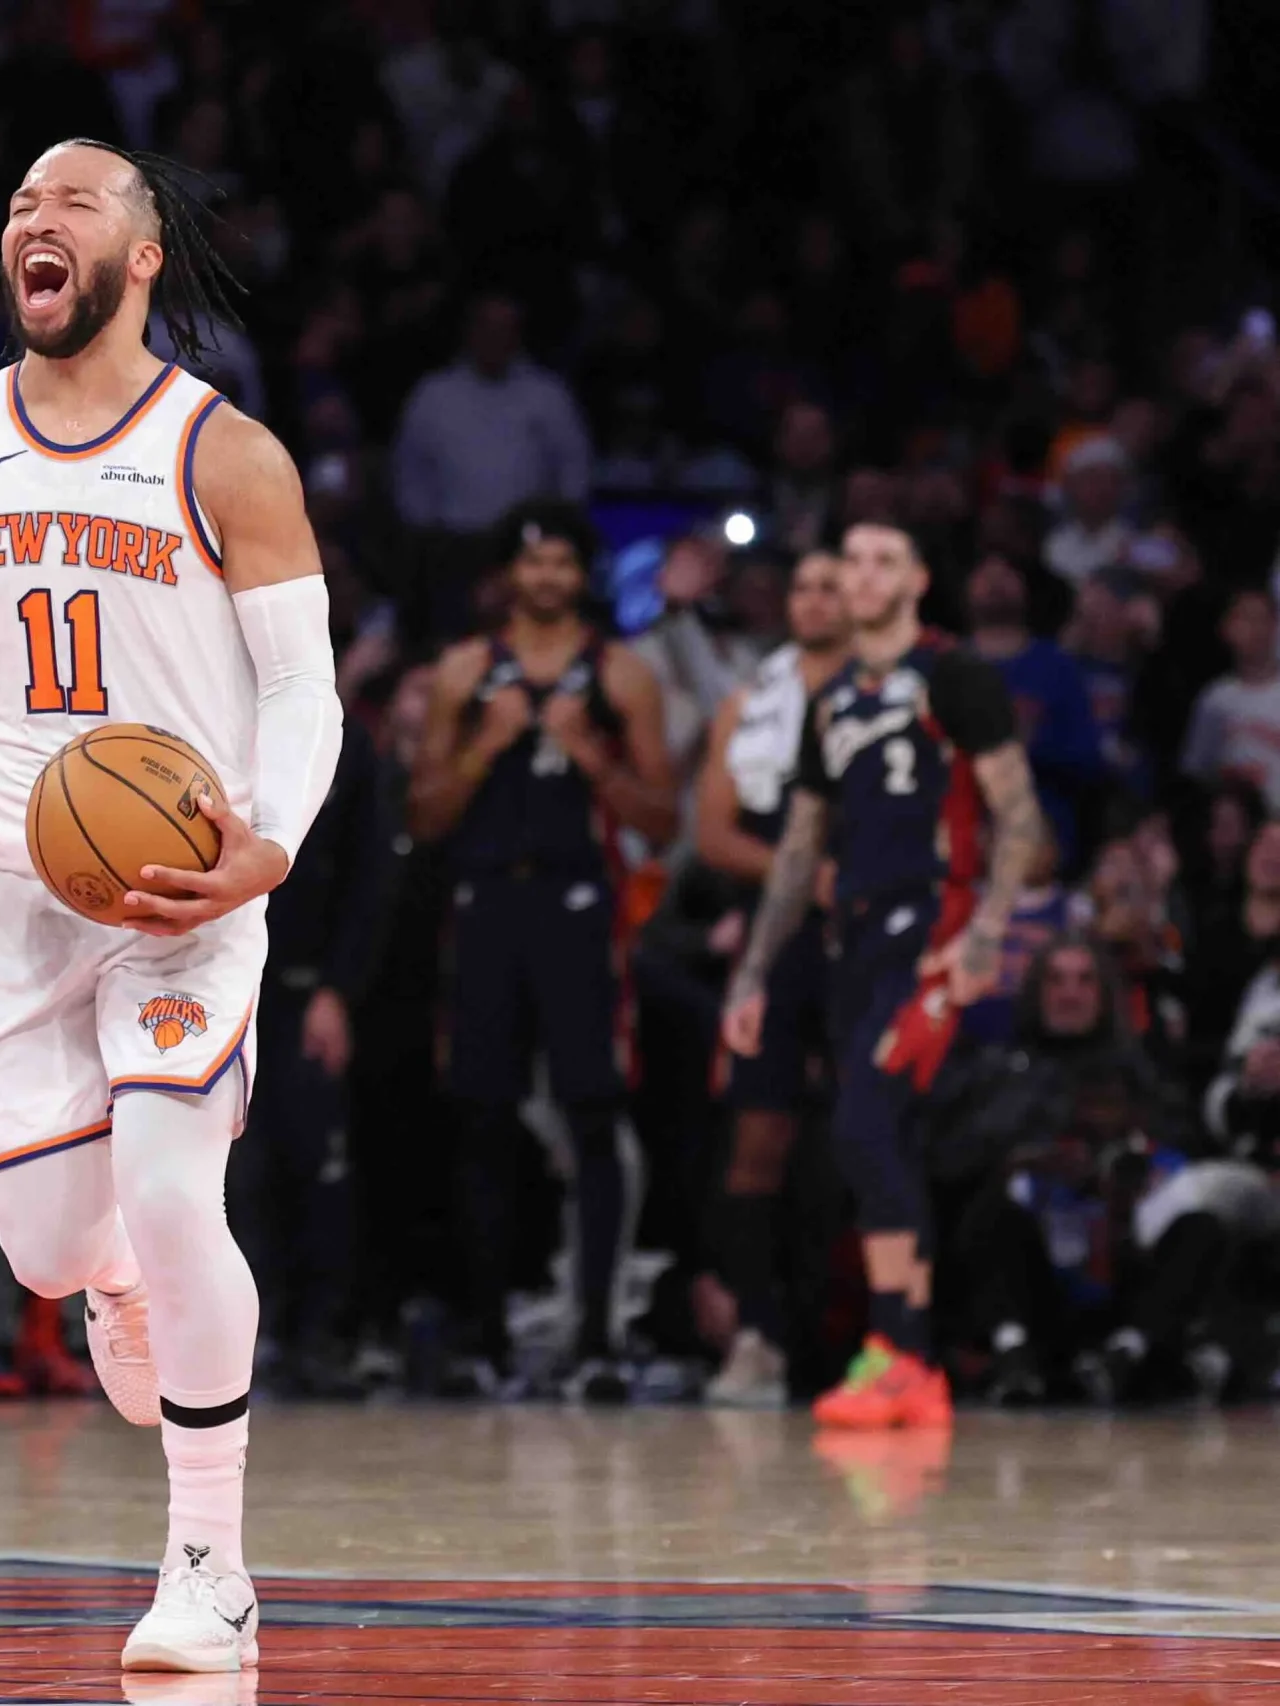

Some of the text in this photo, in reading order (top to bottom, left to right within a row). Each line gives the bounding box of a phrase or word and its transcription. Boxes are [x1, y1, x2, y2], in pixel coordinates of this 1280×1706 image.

[101, 471, 165, 485] abu dhabi
[57, 512, 183, 586] YORK
[17, 588, 108, 715] 11
[883, 737, 918, 796] 2
[138, 996, 207, 1032] KNICKS
